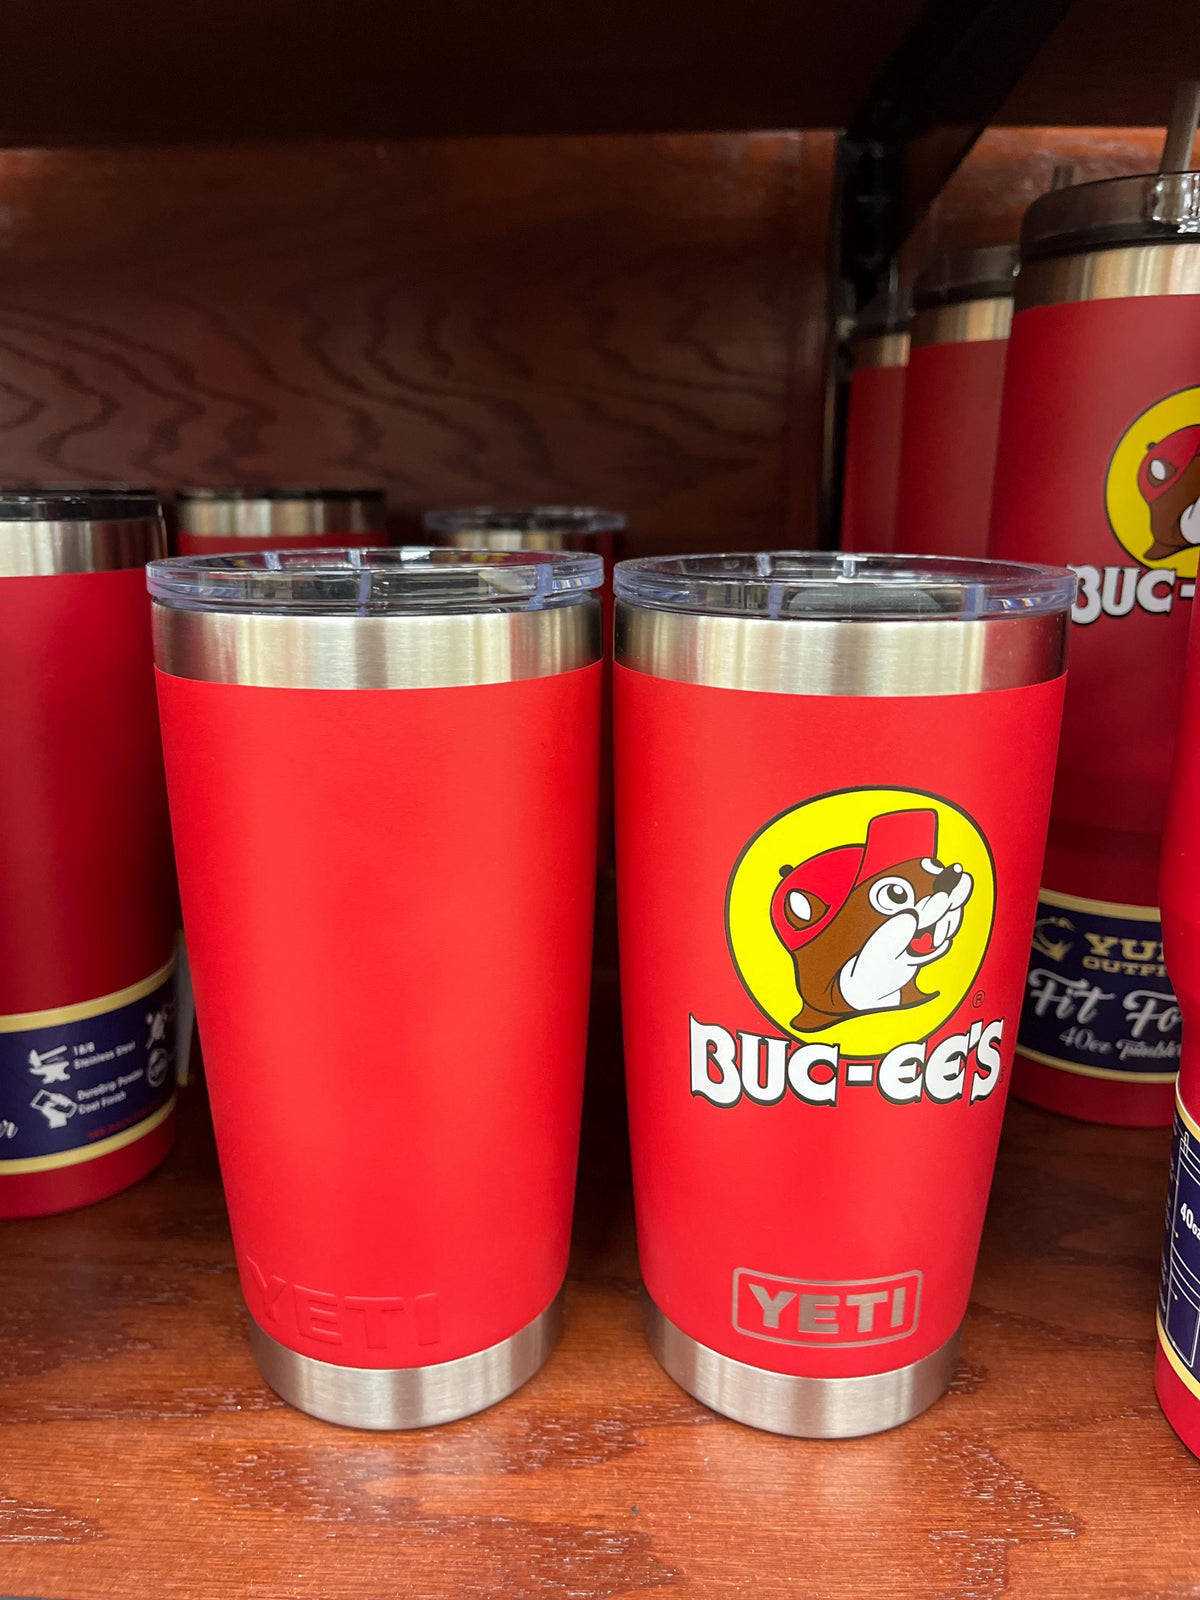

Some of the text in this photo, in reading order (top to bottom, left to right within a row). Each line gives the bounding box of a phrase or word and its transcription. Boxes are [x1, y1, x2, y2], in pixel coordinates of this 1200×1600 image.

[1084, 932, 1164, 962] YU
[1028, 968, 1116, 1024] Fit
[246, 1255, 440, 1350] YETI
[748, 1283, 906, 1334] YETI
